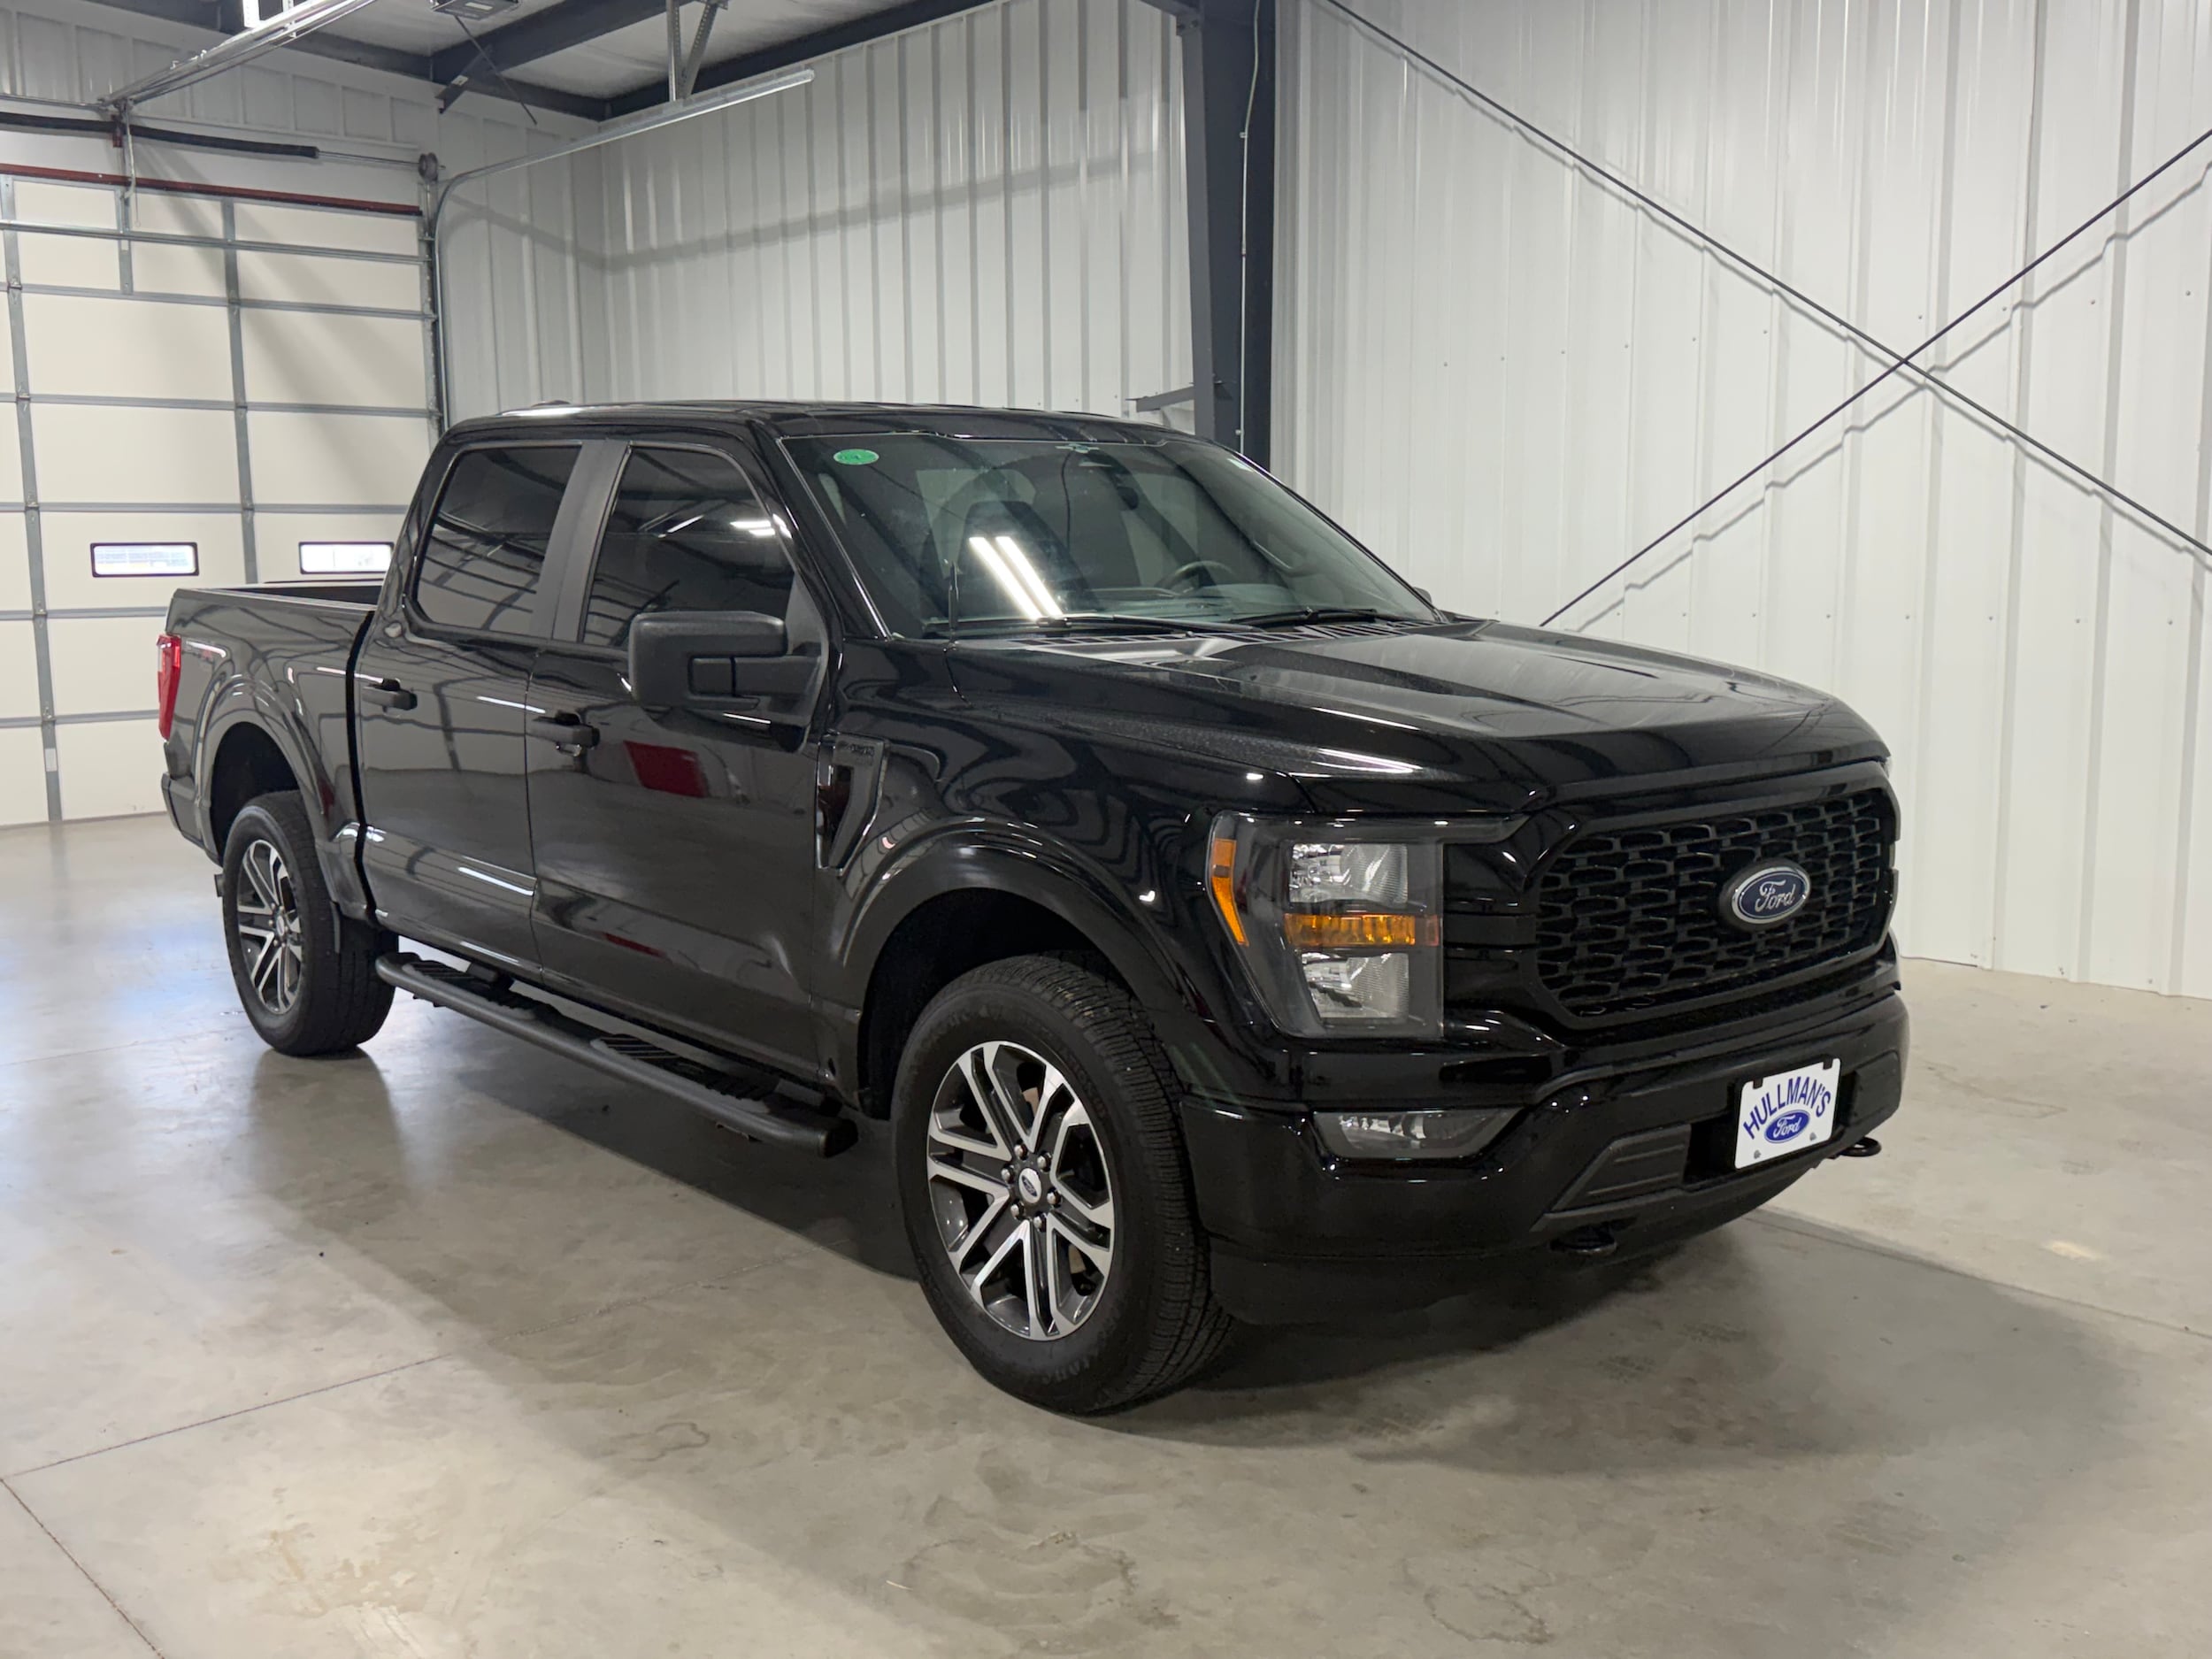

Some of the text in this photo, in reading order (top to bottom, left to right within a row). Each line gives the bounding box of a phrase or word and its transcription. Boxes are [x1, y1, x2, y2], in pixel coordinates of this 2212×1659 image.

[1755, 879, 1796, 912] Ford
[1743, 1076, 1831, 1140] HULLMAN'S
[1772, 1114, 1802, 1138] Ford
